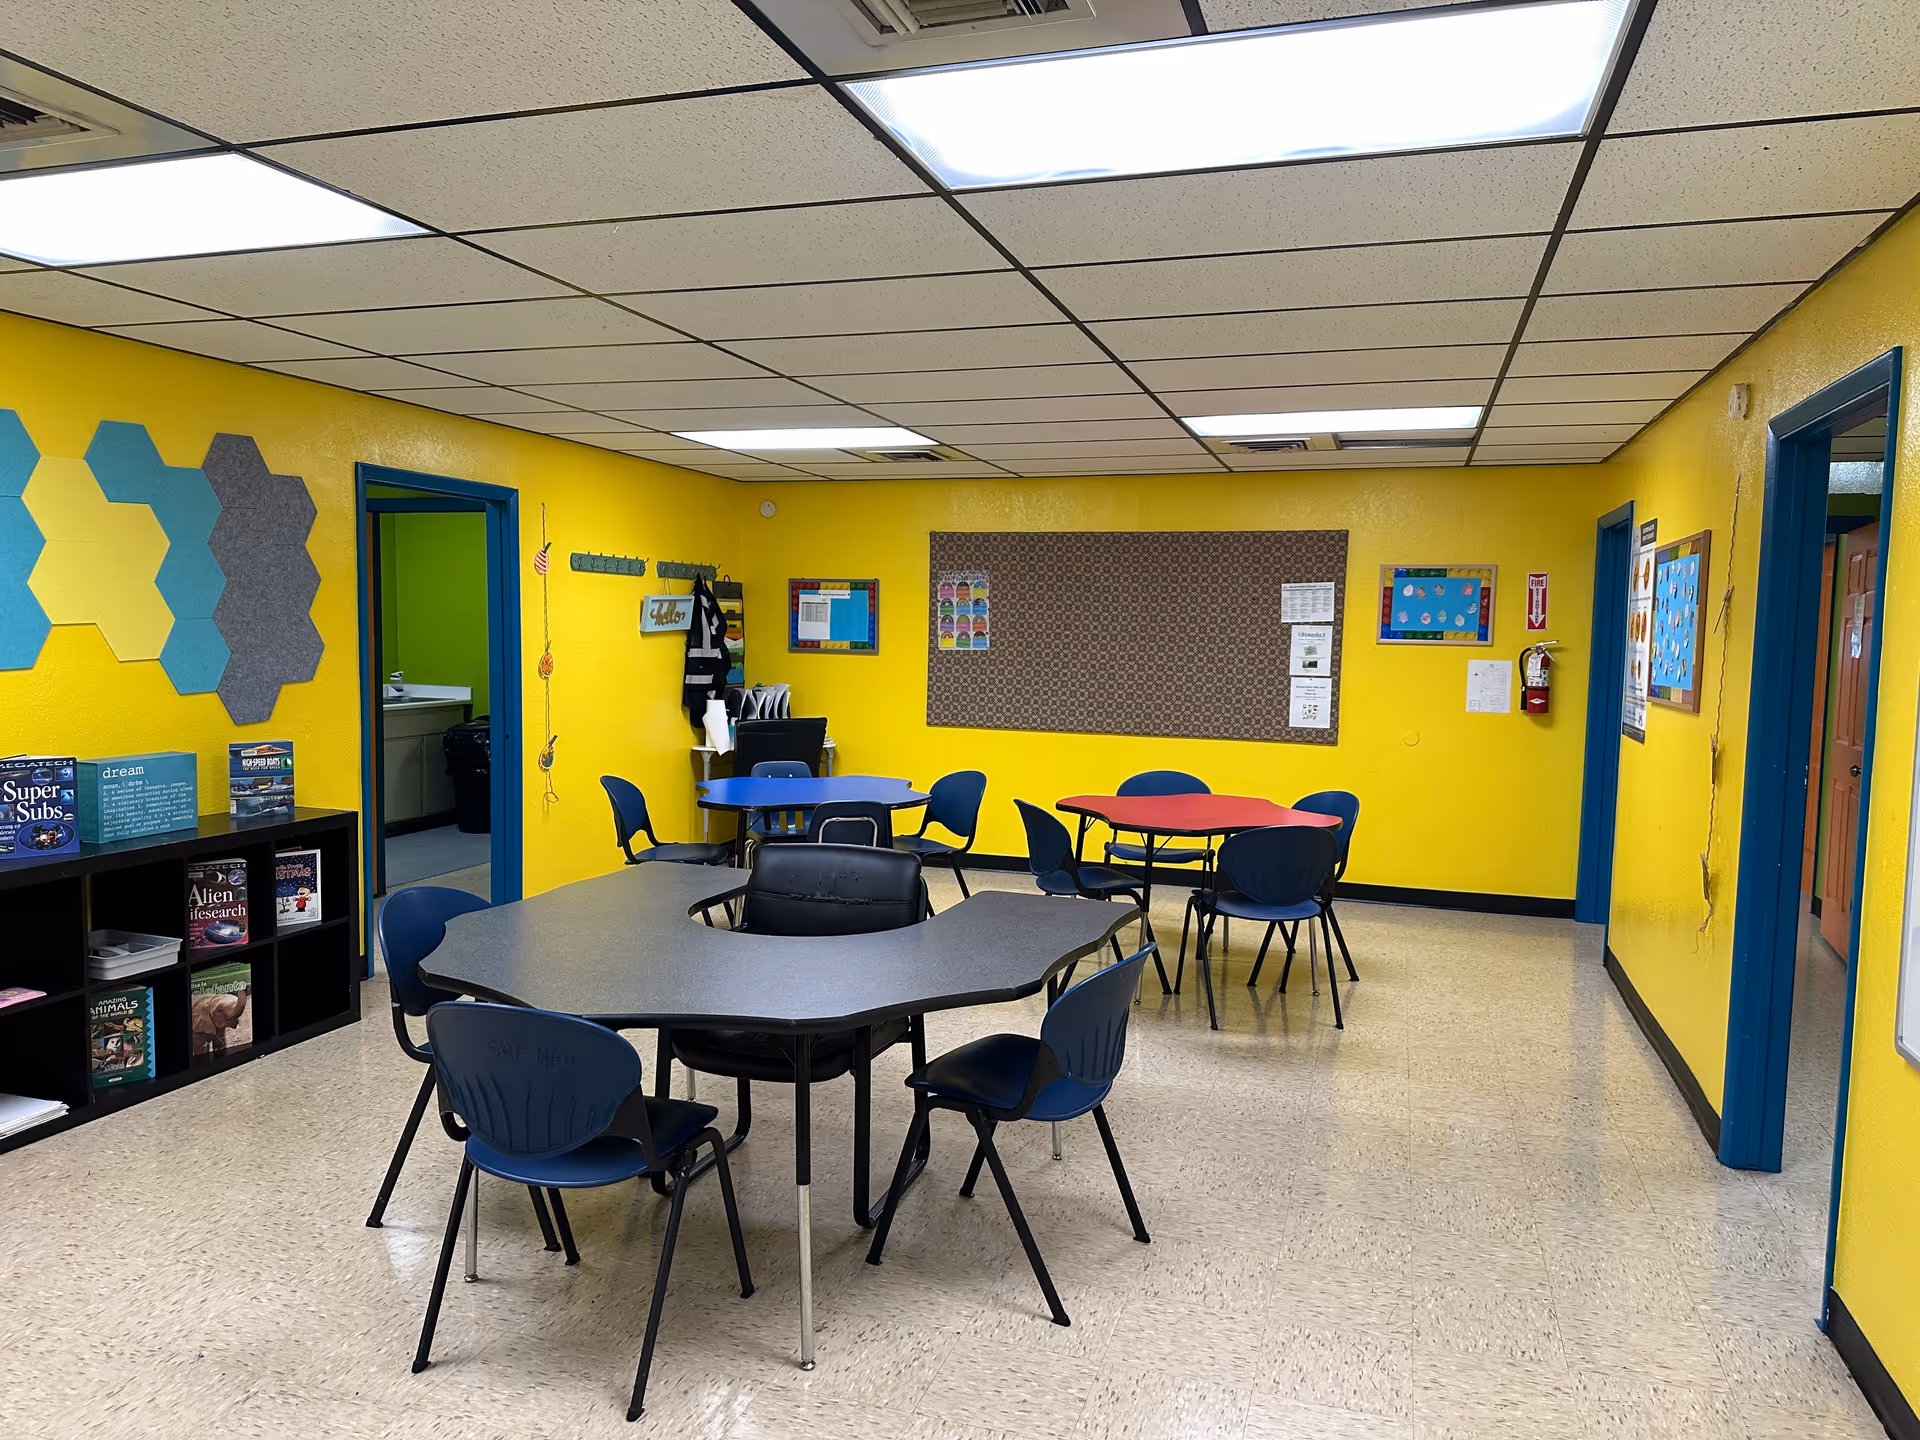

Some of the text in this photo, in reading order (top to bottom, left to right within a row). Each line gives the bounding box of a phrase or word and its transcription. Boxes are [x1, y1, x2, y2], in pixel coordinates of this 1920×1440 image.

[102, 766, 144, 778] dream
[3, 780, 60, 804] Super
[16, 801, 63, 822] Subs
[276, 867, 311, 879] ISTMAS
[189, 884, 234, 907] Alien
[190, 904, 246, 920] ifesearch
[98, 996, 127, 1006] AMAZING
